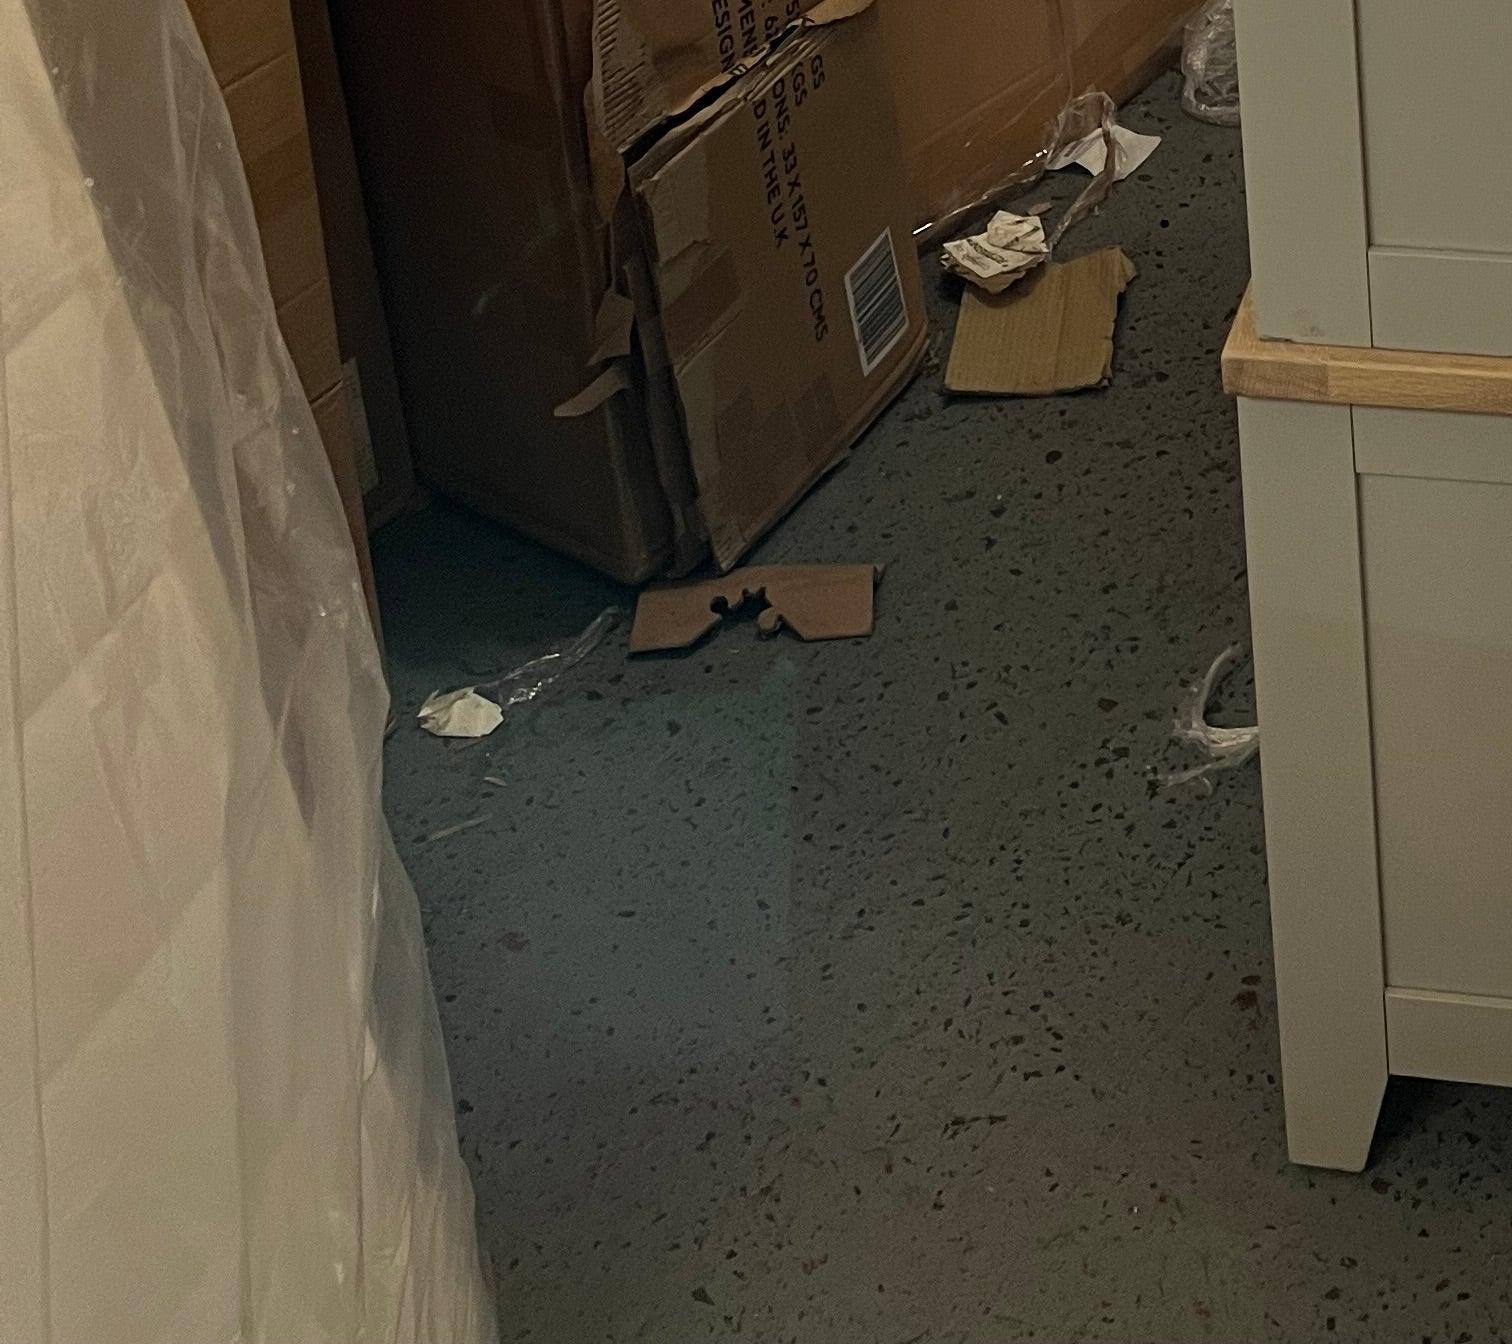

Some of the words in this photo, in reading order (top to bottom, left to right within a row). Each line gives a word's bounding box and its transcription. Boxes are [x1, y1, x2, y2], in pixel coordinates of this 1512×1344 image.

[757, 124, 773, 152] IN
[783, 142, 798, 176] 33
[760, 156, 781, 205] THE
[787, 174, 801, 197] X
[770, 205, 788, 249] U.K
[789, 195, 809, 231] 157
[798, 232, 812, 255] X
[800, 254, 818, 286] 70
[809, 288, 828, 342] CMS
